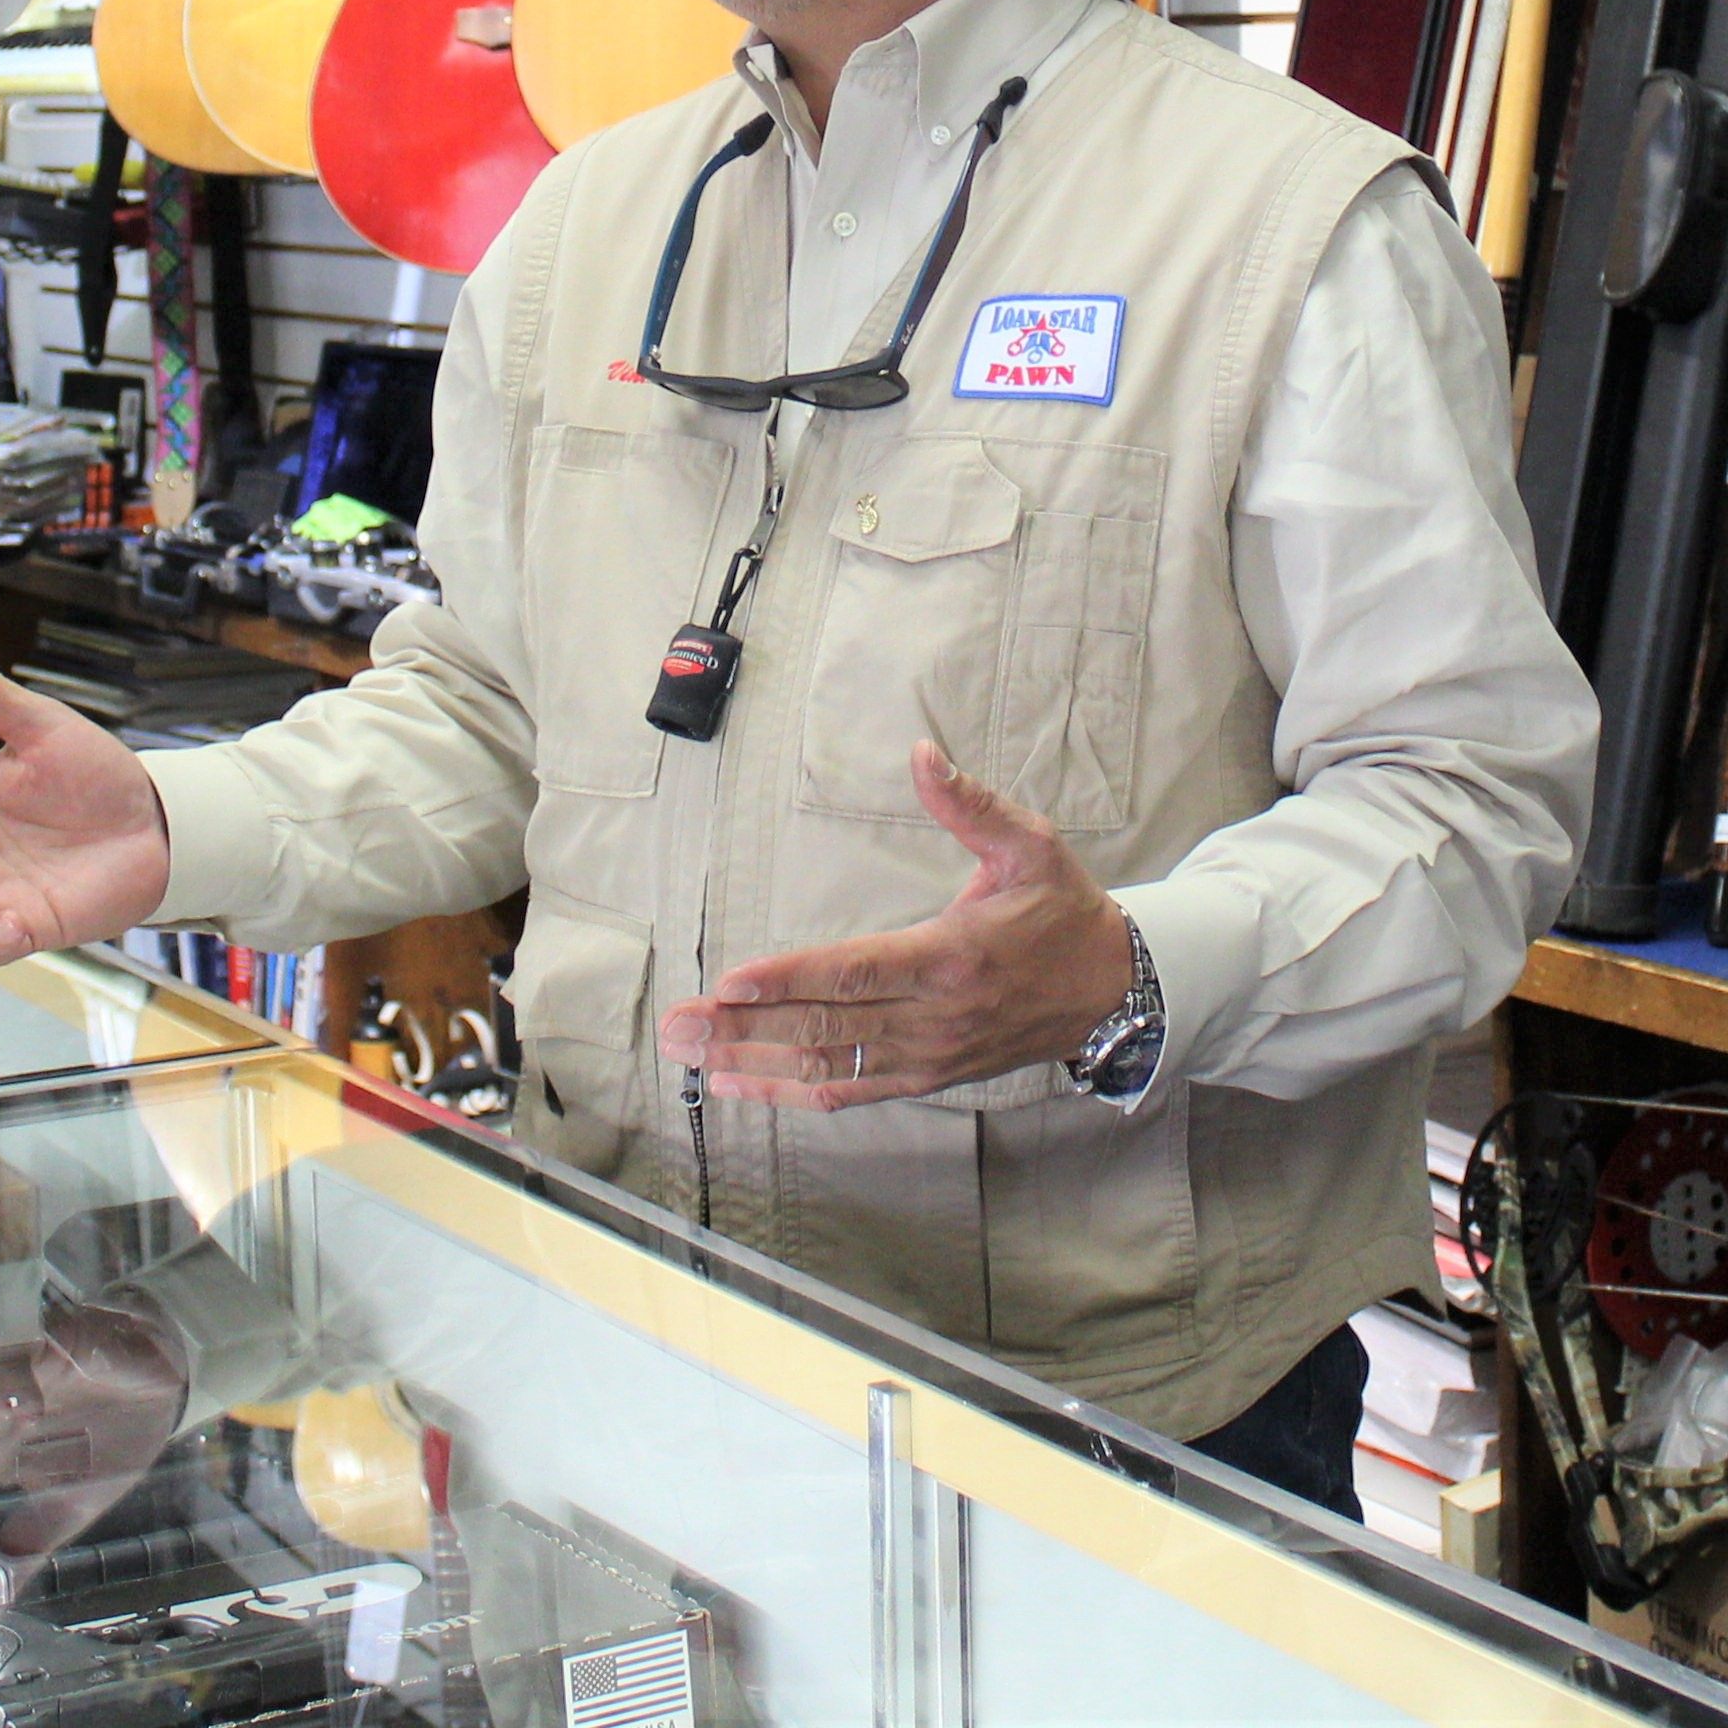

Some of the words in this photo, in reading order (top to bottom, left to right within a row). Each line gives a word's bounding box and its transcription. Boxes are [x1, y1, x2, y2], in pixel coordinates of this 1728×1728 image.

[990, 306, 1040, 335] LOAN
[1048, 305, 1098, 335] STAR
[985, 363, 1076, 387] PAWN
